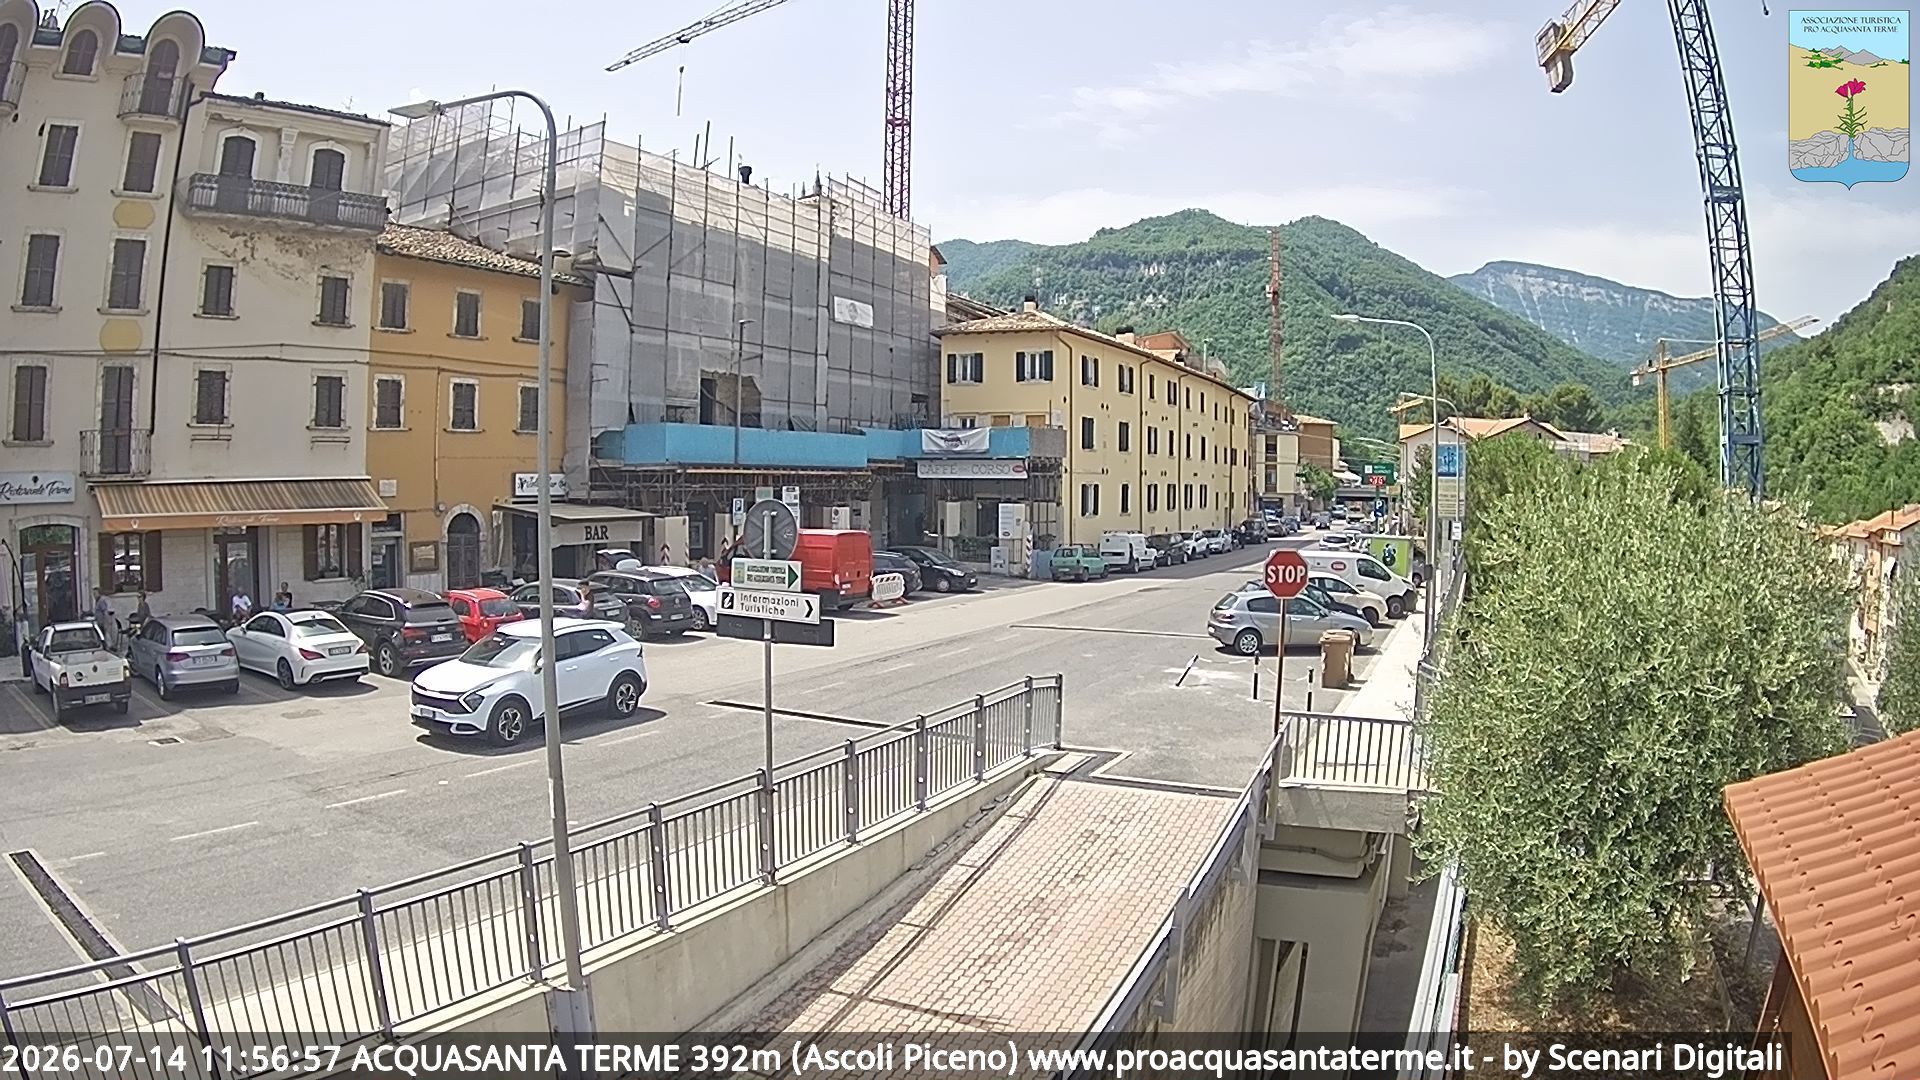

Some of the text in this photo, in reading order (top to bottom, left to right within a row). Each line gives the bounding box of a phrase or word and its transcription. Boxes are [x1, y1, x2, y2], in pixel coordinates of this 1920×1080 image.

[971, 464, 1010, 475] CORSO
[584, 525, 609, 541] BAR
[1267, 565, 1306, 584] STOP
[740, 593, 799, 607] Informazioni
[740, 603, 785, 616] Turistiche
